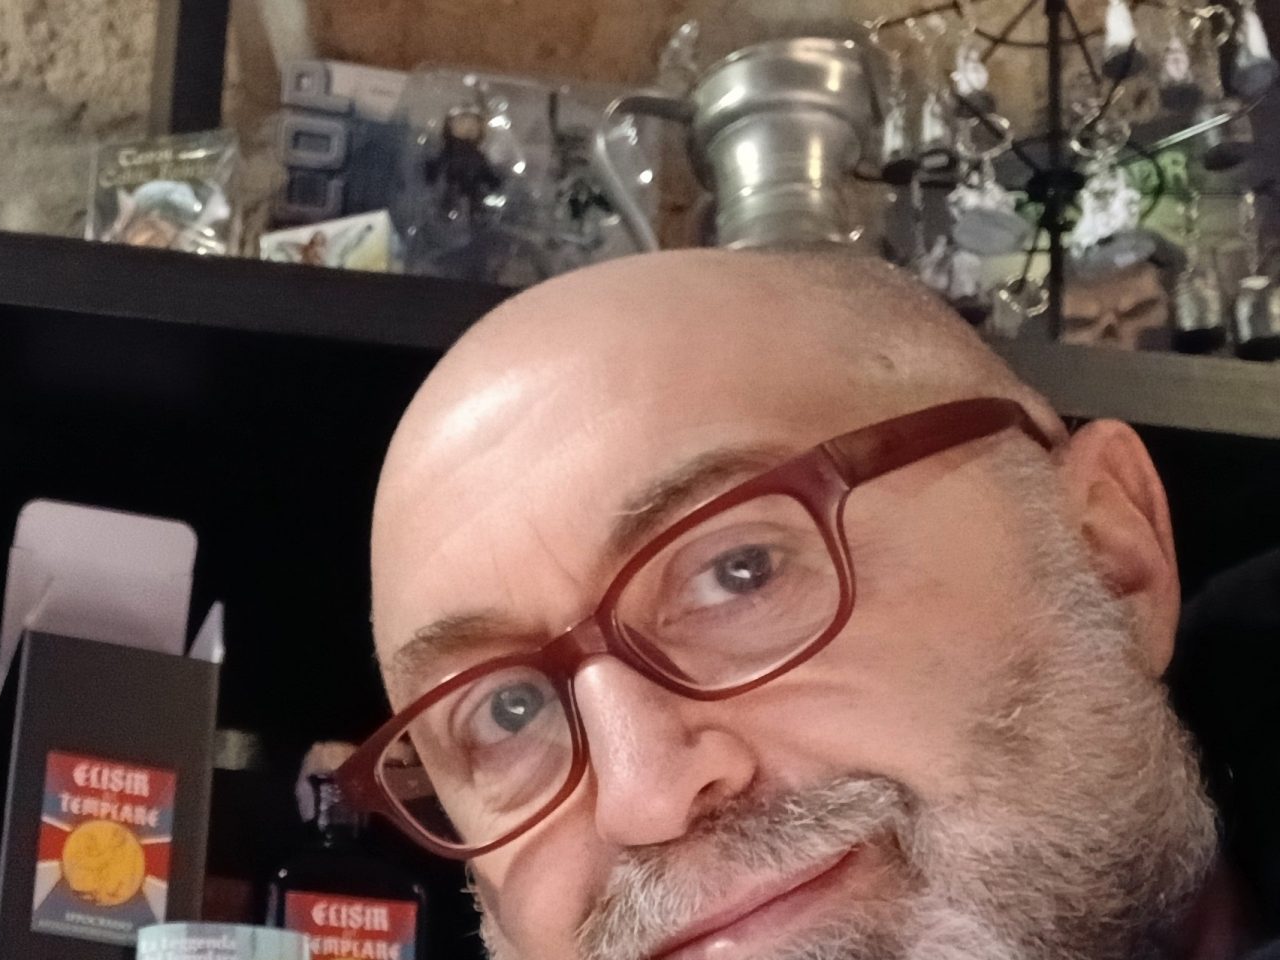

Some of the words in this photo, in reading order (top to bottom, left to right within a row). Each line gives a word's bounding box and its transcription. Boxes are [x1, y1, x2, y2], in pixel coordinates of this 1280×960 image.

[72, 762, 150, 797] ELISIR
[59, 792, 159, 828] TEMPLARE
[310, 900, 389, 931] ELISIR
[308, 935, 401, 960] EMPLARE
